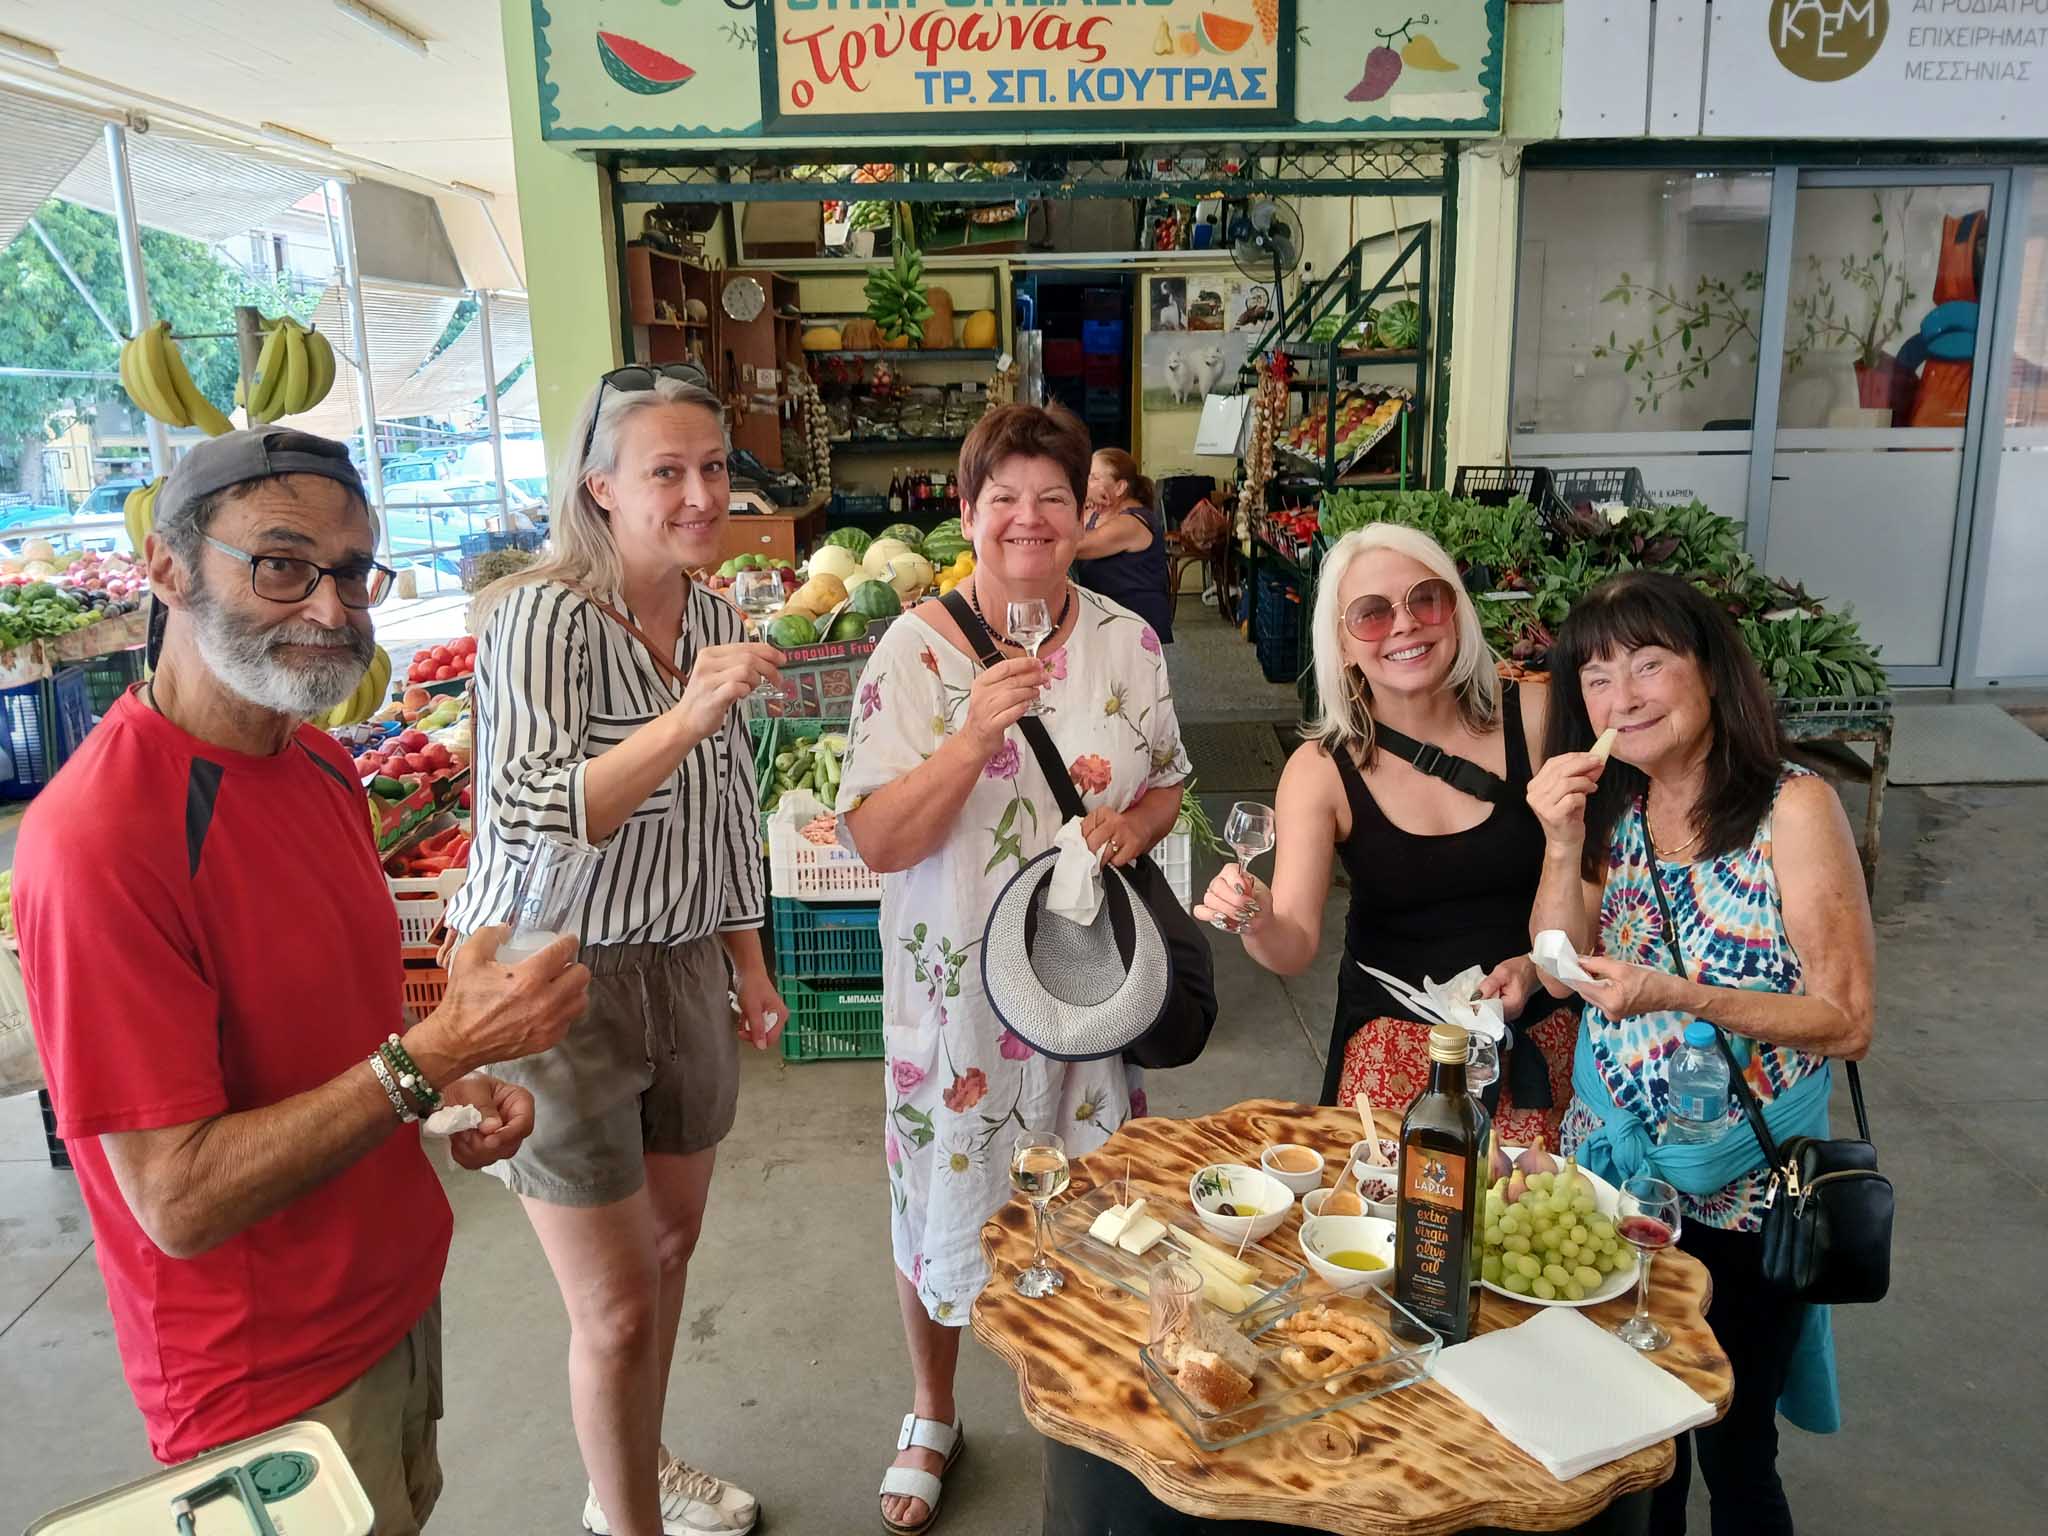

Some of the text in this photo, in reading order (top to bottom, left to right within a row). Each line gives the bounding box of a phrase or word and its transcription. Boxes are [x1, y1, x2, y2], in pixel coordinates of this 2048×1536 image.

[783, 8, 1113, 93] Τρύφωνας
[1905, 60, 2033, 81] ΜΕΣΣΗΝΙΑΣ
[914, 67, 1268, 105] ΤΡ. ΣΠ. ΚΟΥΤΡΑΣ
[1414, 1178, 1455, 1198] LADIKI
[1416, 1208, 1448, 1225] extra
[1415, 1225, 1449, 1243] virgin
[1416, 1241, 1446, 1259] olive
[1420, 1260, 1440, 1275] oil
